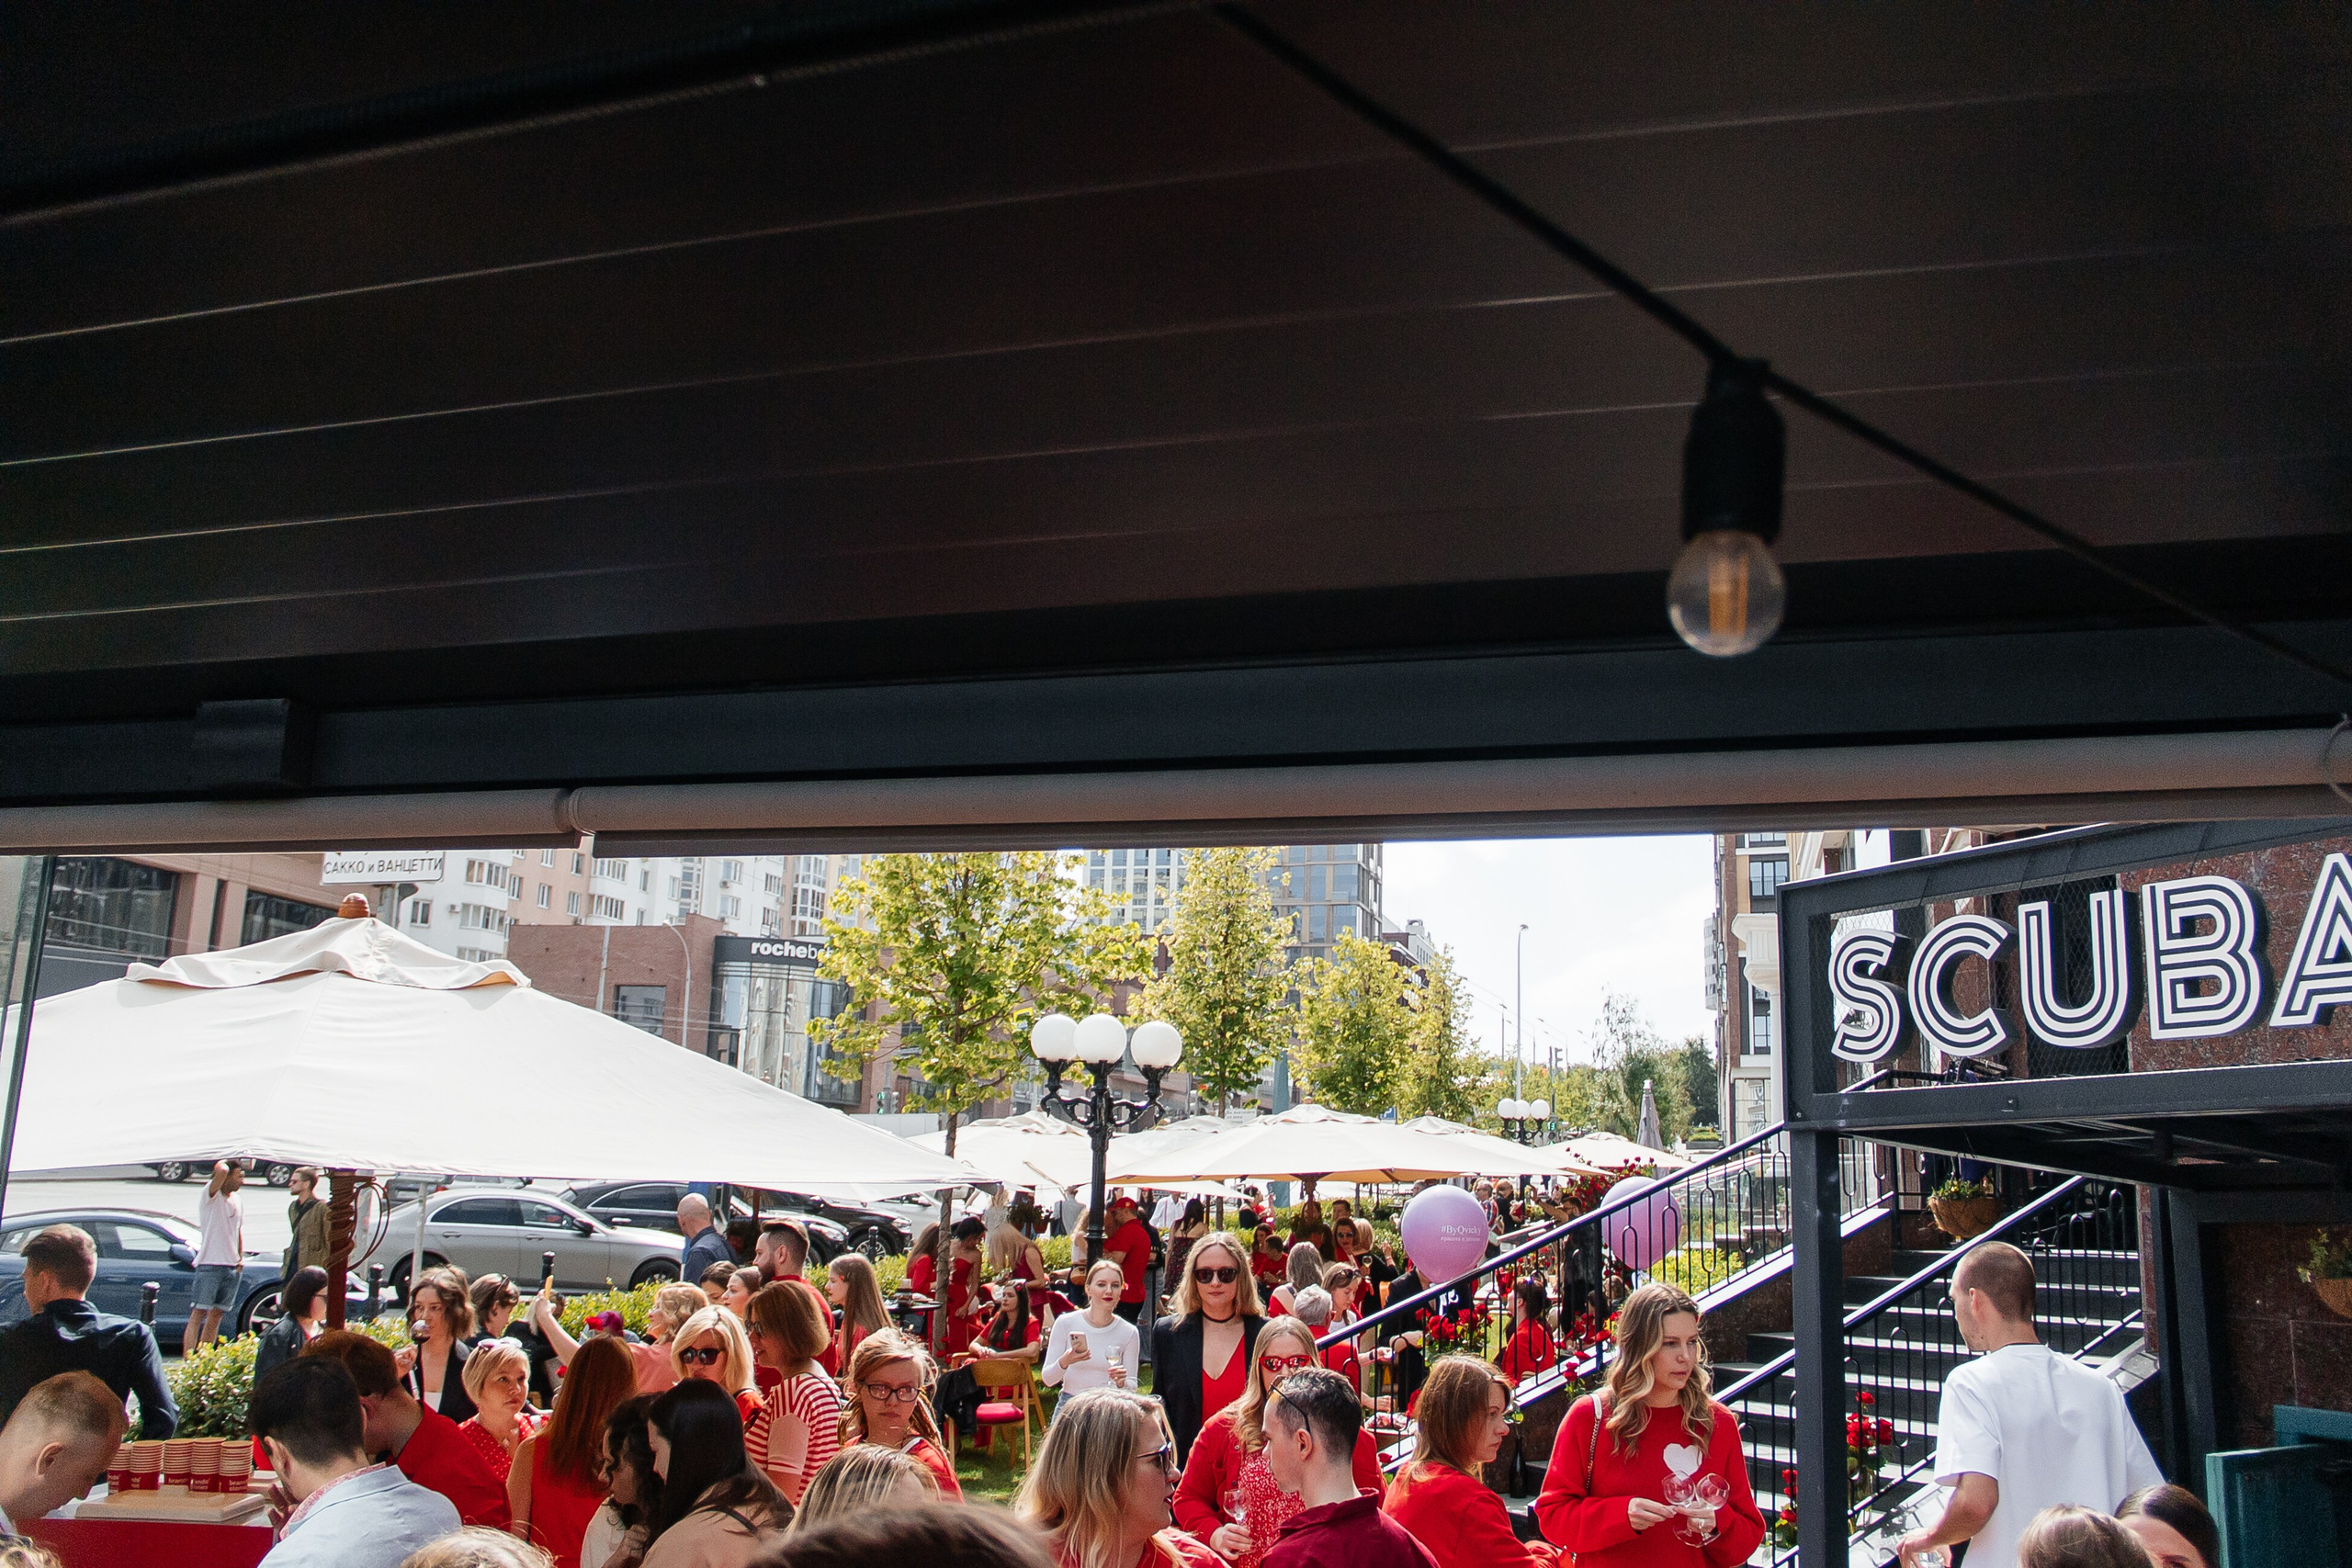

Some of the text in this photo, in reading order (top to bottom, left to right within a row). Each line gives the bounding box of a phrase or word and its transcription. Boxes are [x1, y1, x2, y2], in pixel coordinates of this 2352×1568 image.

[323, 857, 443, 874] САККО и ВАНЦЕТТИ
[1828, 852, 2352, 1063] SCUBA
